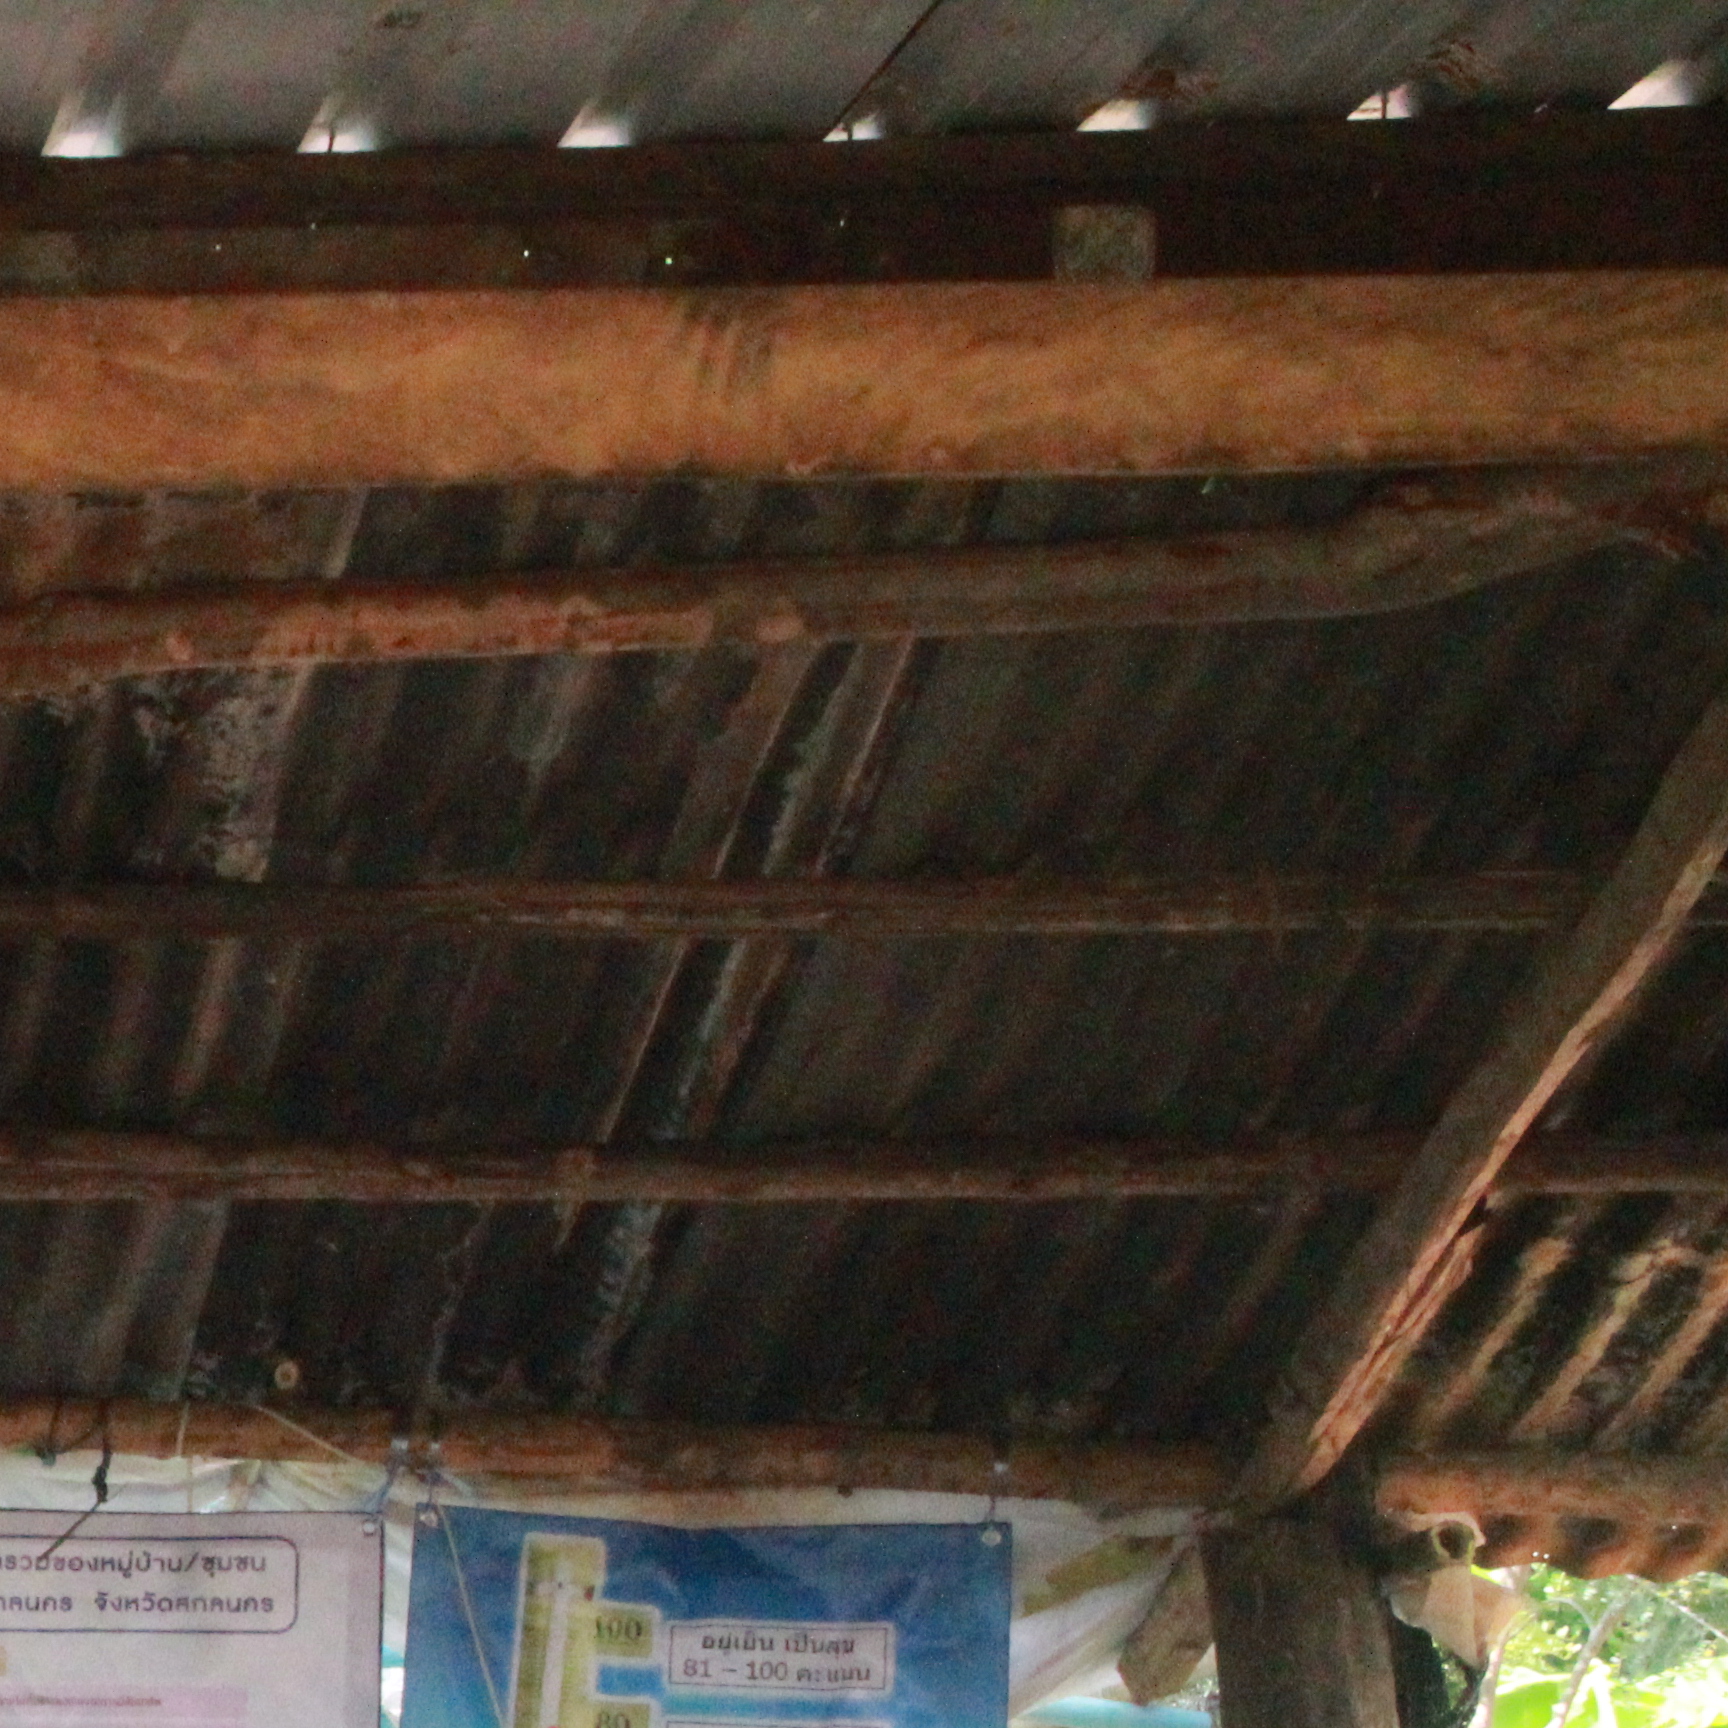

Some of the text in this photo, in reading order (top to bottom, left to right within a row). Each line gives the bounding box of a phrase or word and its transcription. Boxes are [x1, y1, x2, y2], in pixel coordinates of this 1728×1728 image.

[94, 1591, 274, 1613] จังหวัดสกลนคร
[595, 1616, 642, 1640] 100
[683, 1659, 711, 1678] 81
[746, 1661, 788, 1681] 100
[797, 1665, 871, 1683] คะแนน
